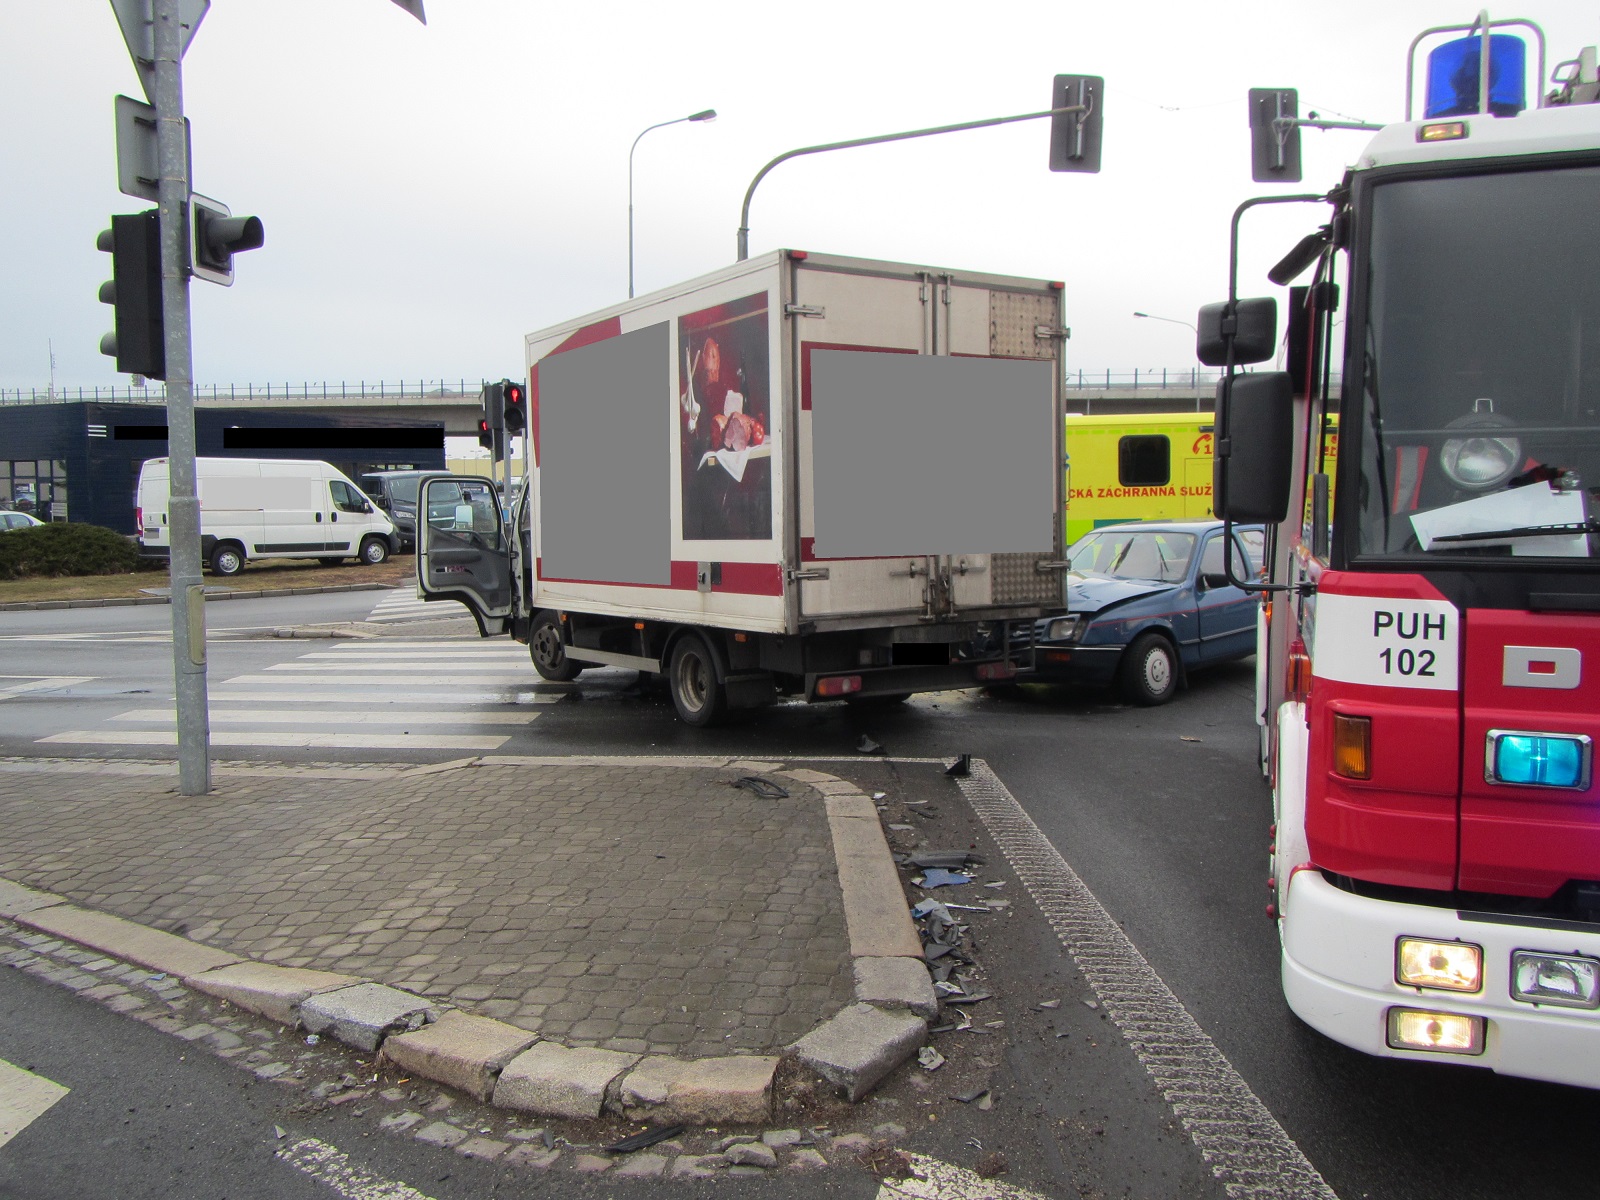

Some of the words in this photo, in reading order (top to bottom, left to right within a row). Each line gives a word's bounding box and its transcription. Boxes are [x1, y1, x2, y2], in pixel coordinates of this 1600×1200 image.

[1097, 484, 1176, 499] ZÁCHRANNÁ
[1373, 610, 1446, 641] PUH
[1379, 647, 1436, 677] 102
